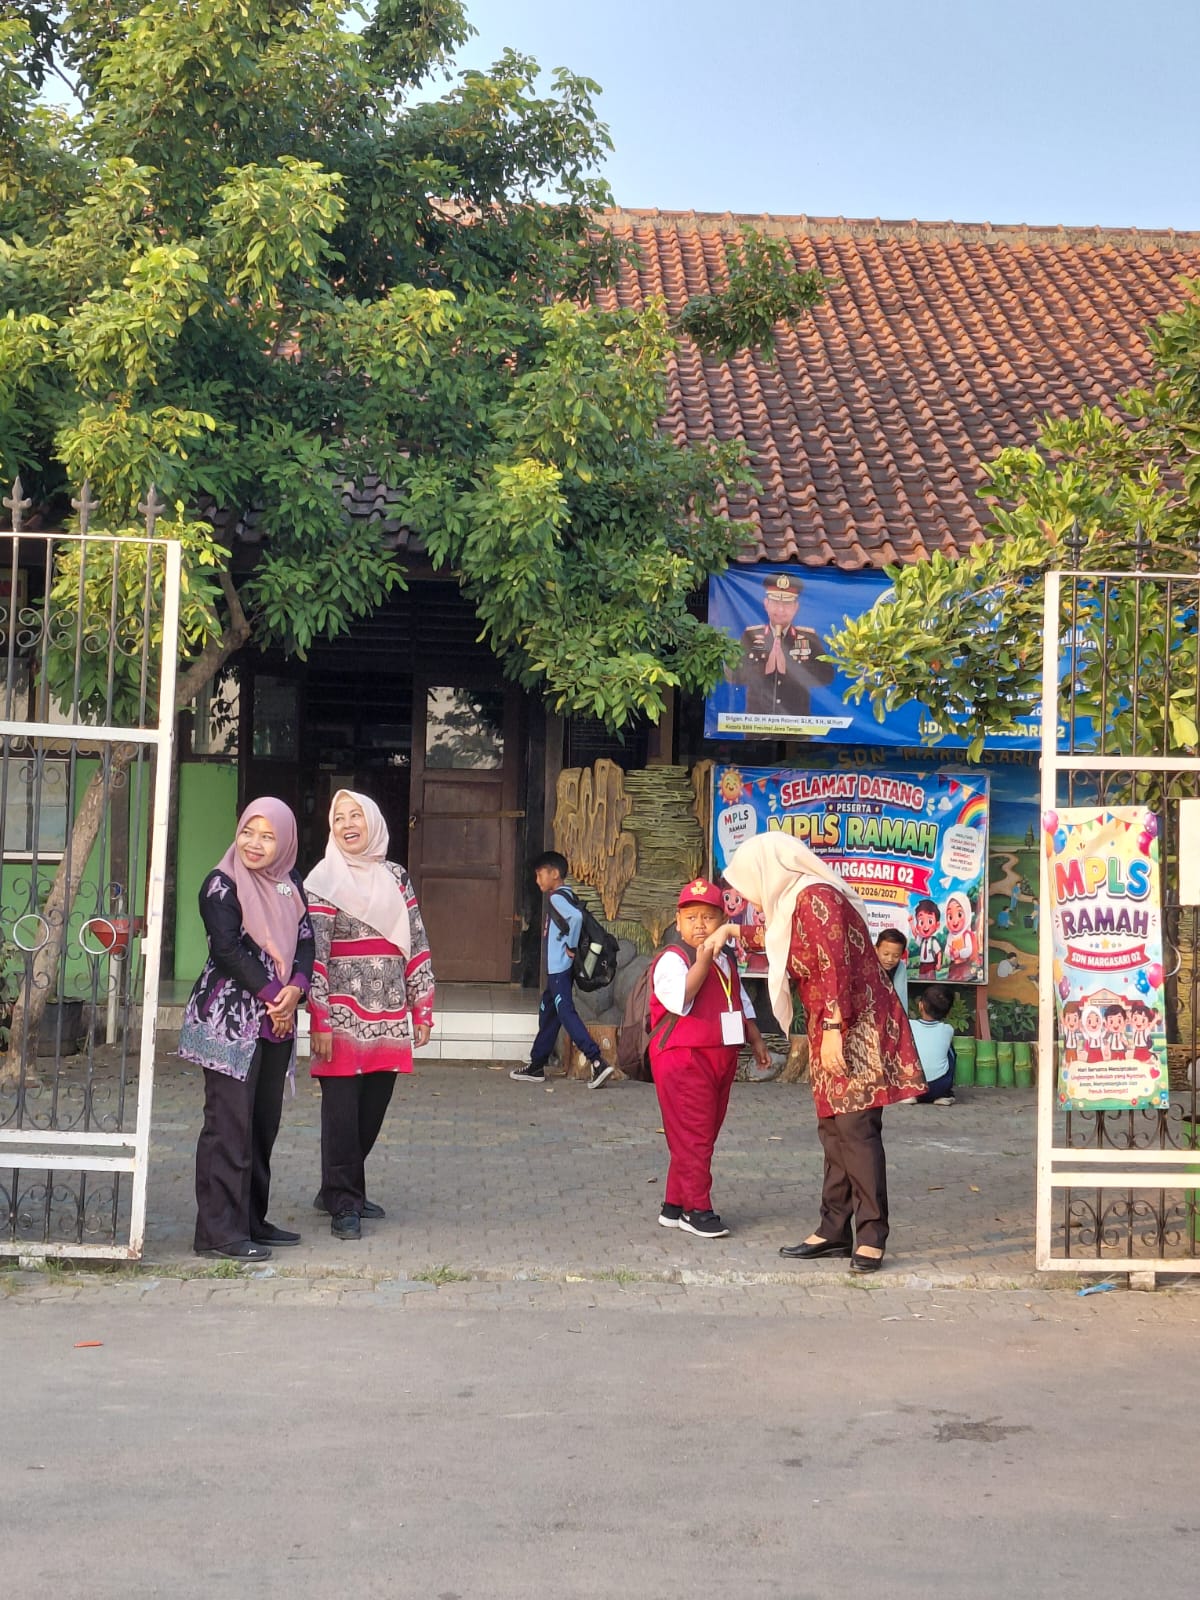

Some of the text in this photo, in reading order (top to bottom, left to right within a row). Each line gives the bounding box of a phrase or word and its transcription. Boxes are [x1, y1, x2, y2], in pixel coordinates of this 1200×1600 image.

[838, 748, 1033, 769] SDN MARGSARI
[780, 774, 925, 810] SELAMAT DATANG
[724, 810, 749, 826] MPLS
[836, 803, 872, 814] PESERTA
[729, 823, 747, 833] RAMAH
[845, 815, 938, 859] RAMAH
[897, 866, 914, 885] 02
[1055, 857, 1151, 905] MPLS
[861, 886, 898, 900] 2026/2027
[1061, 906, 1149, 940] RAMAH
[1071, 951, 1141, 967] SDN MARGASARI 02
